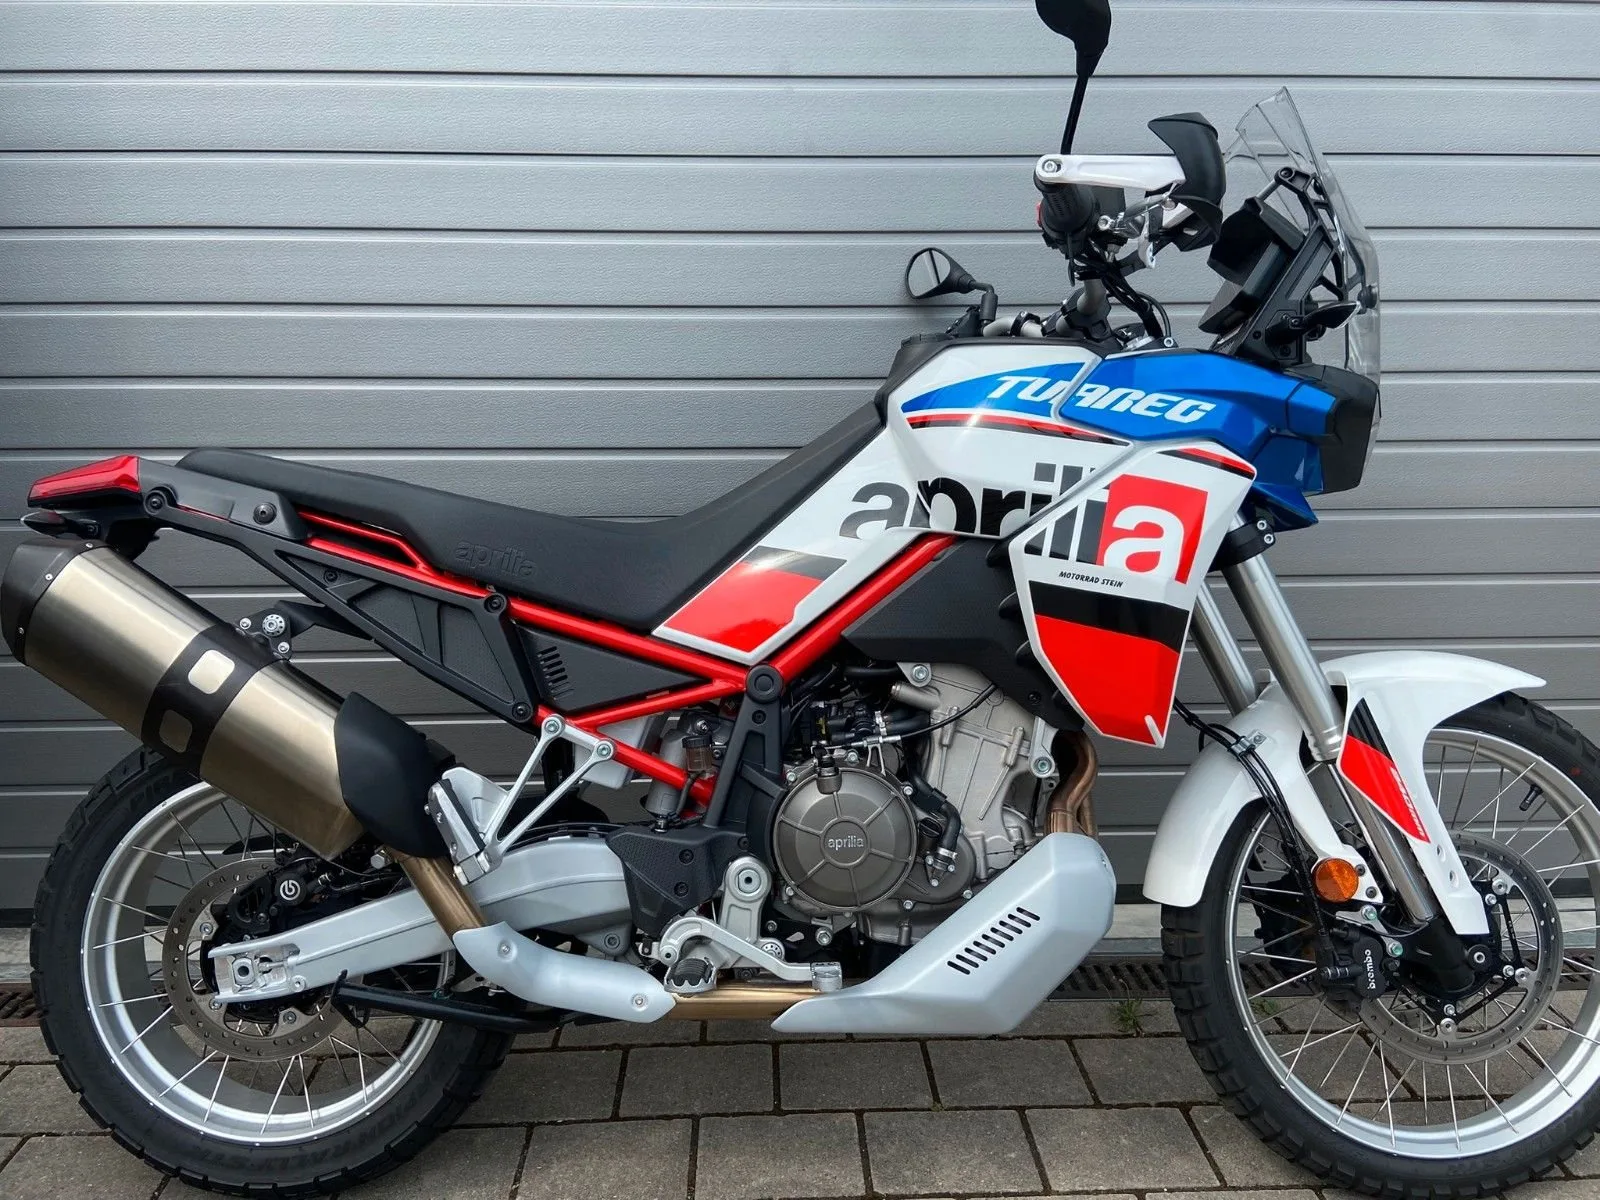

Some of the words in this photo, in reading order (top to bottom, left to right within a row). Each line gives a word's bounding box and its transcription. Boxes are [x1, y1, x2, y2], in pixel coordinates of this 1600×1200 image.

[987, 376, 1216, 423] TUAREG
[838, 462, 1188, 580] aprilia
[455, 541, 537, 577] aprilia
[1059, 571, 1100, 584] MOTORRAD
[1101, 578, 1123, 589] STEIN
[828, 836, 864, 851] aprilia
[1365, 949, 1376, 990] brembo
